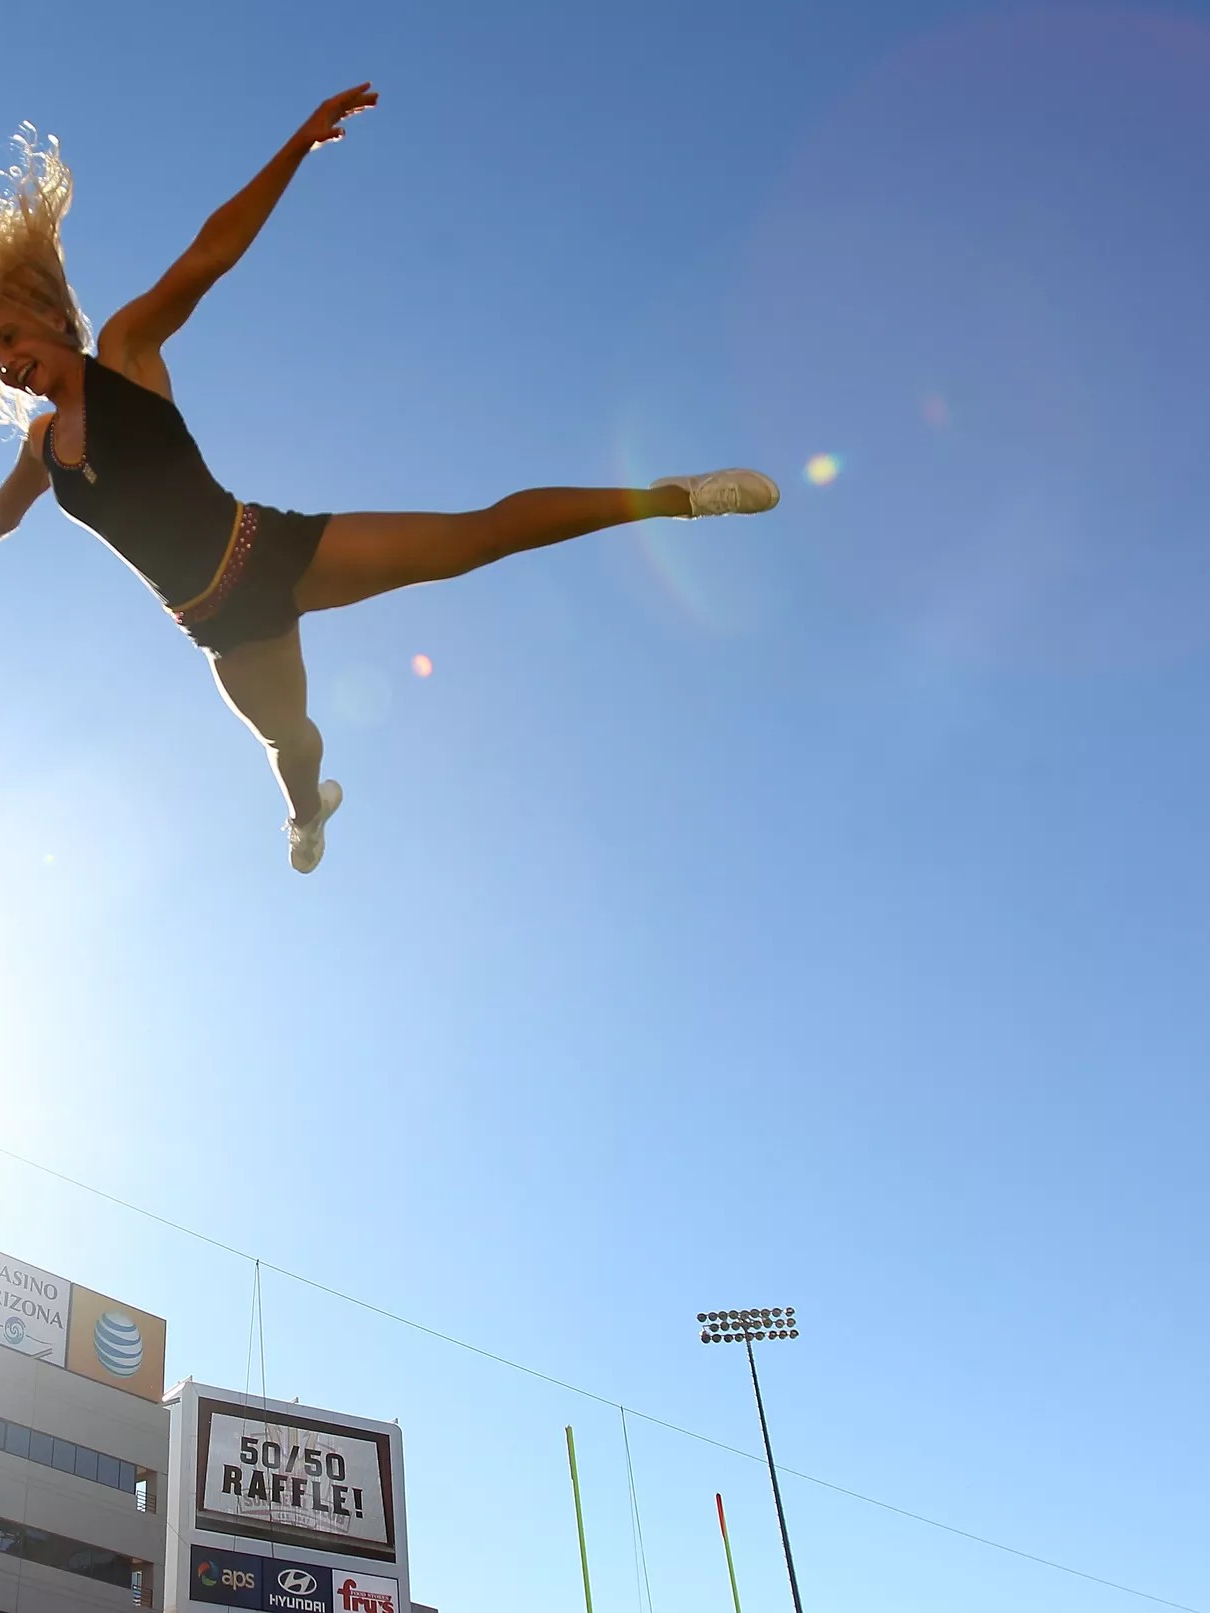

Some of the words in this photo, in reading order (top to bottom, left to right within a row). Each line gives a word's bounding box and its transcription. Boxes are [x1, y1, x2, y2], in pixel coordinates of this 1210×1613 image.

[240, 1436, 345, 1481] 50/50
[222, 1464, 363, 1518] RAFFLE!
[222, 1568, 255, 1590] aps
[270, 1594, 326, 1613] HYUNDAI
